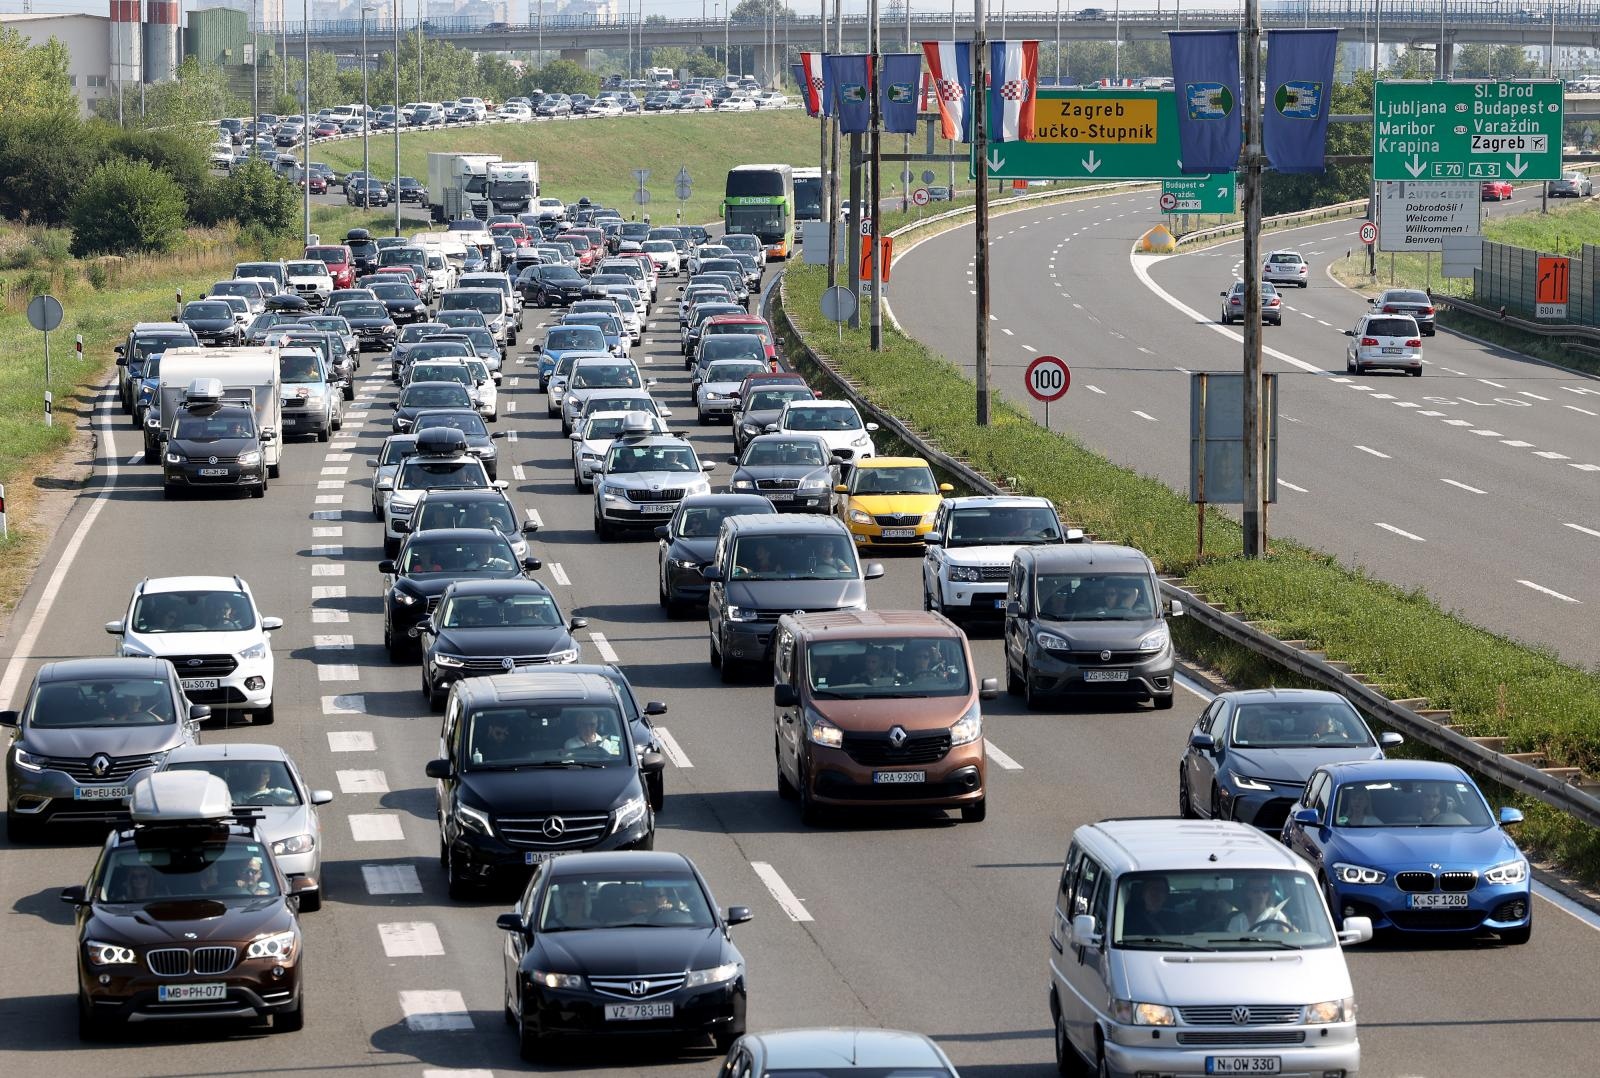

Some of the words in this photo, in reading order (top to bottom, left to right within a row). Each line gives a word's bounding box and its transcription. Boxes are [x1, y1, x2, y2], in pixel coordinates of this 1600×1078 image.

[1475, 84, 1492, 97] Sl.
[1499, 84, 1534, 97] Brod
[1061, 101, 1124, 119] Zagreb
[1379, 101, 1447, 117] Ljubljana
[1474, 101, 1544, 117] Budapest
[1379, 121, 1436, 135] Maribor
[1474, 118, 1540, 133] Varaždin
[1034, 124, 1153, 141] učko-Stupnik
[1379, 138, 1440, 155] Krapina
[1472, 136, 1525, 152] Zagreb
[1436, 165, 1442, 175] E
[1446, 165, 1461, 175] 70
[1475, 165, 1482, 175] A
[1488, 165, 1495, 175] 3
[1405, 202, 1457, 211] Dobrodošli
[1406, 214, 1448, 222] Welcome
[1363, 228, 1375, 239] 80
[1406, 225, 1463, 233] Willkommen
[1540, 307, 1554, 315] 600
[1034, 368, 1064, 389] 100
[878, 772, 895, 782] KRA
[1413, 894, 1420, 905] K
[1427, 894, 1439, 905] SF
[1442, 893, 1467, 905] 1286
[1217, 1058, 1226, 1071] N
[1252, 1058, 1275, 1071] 330
